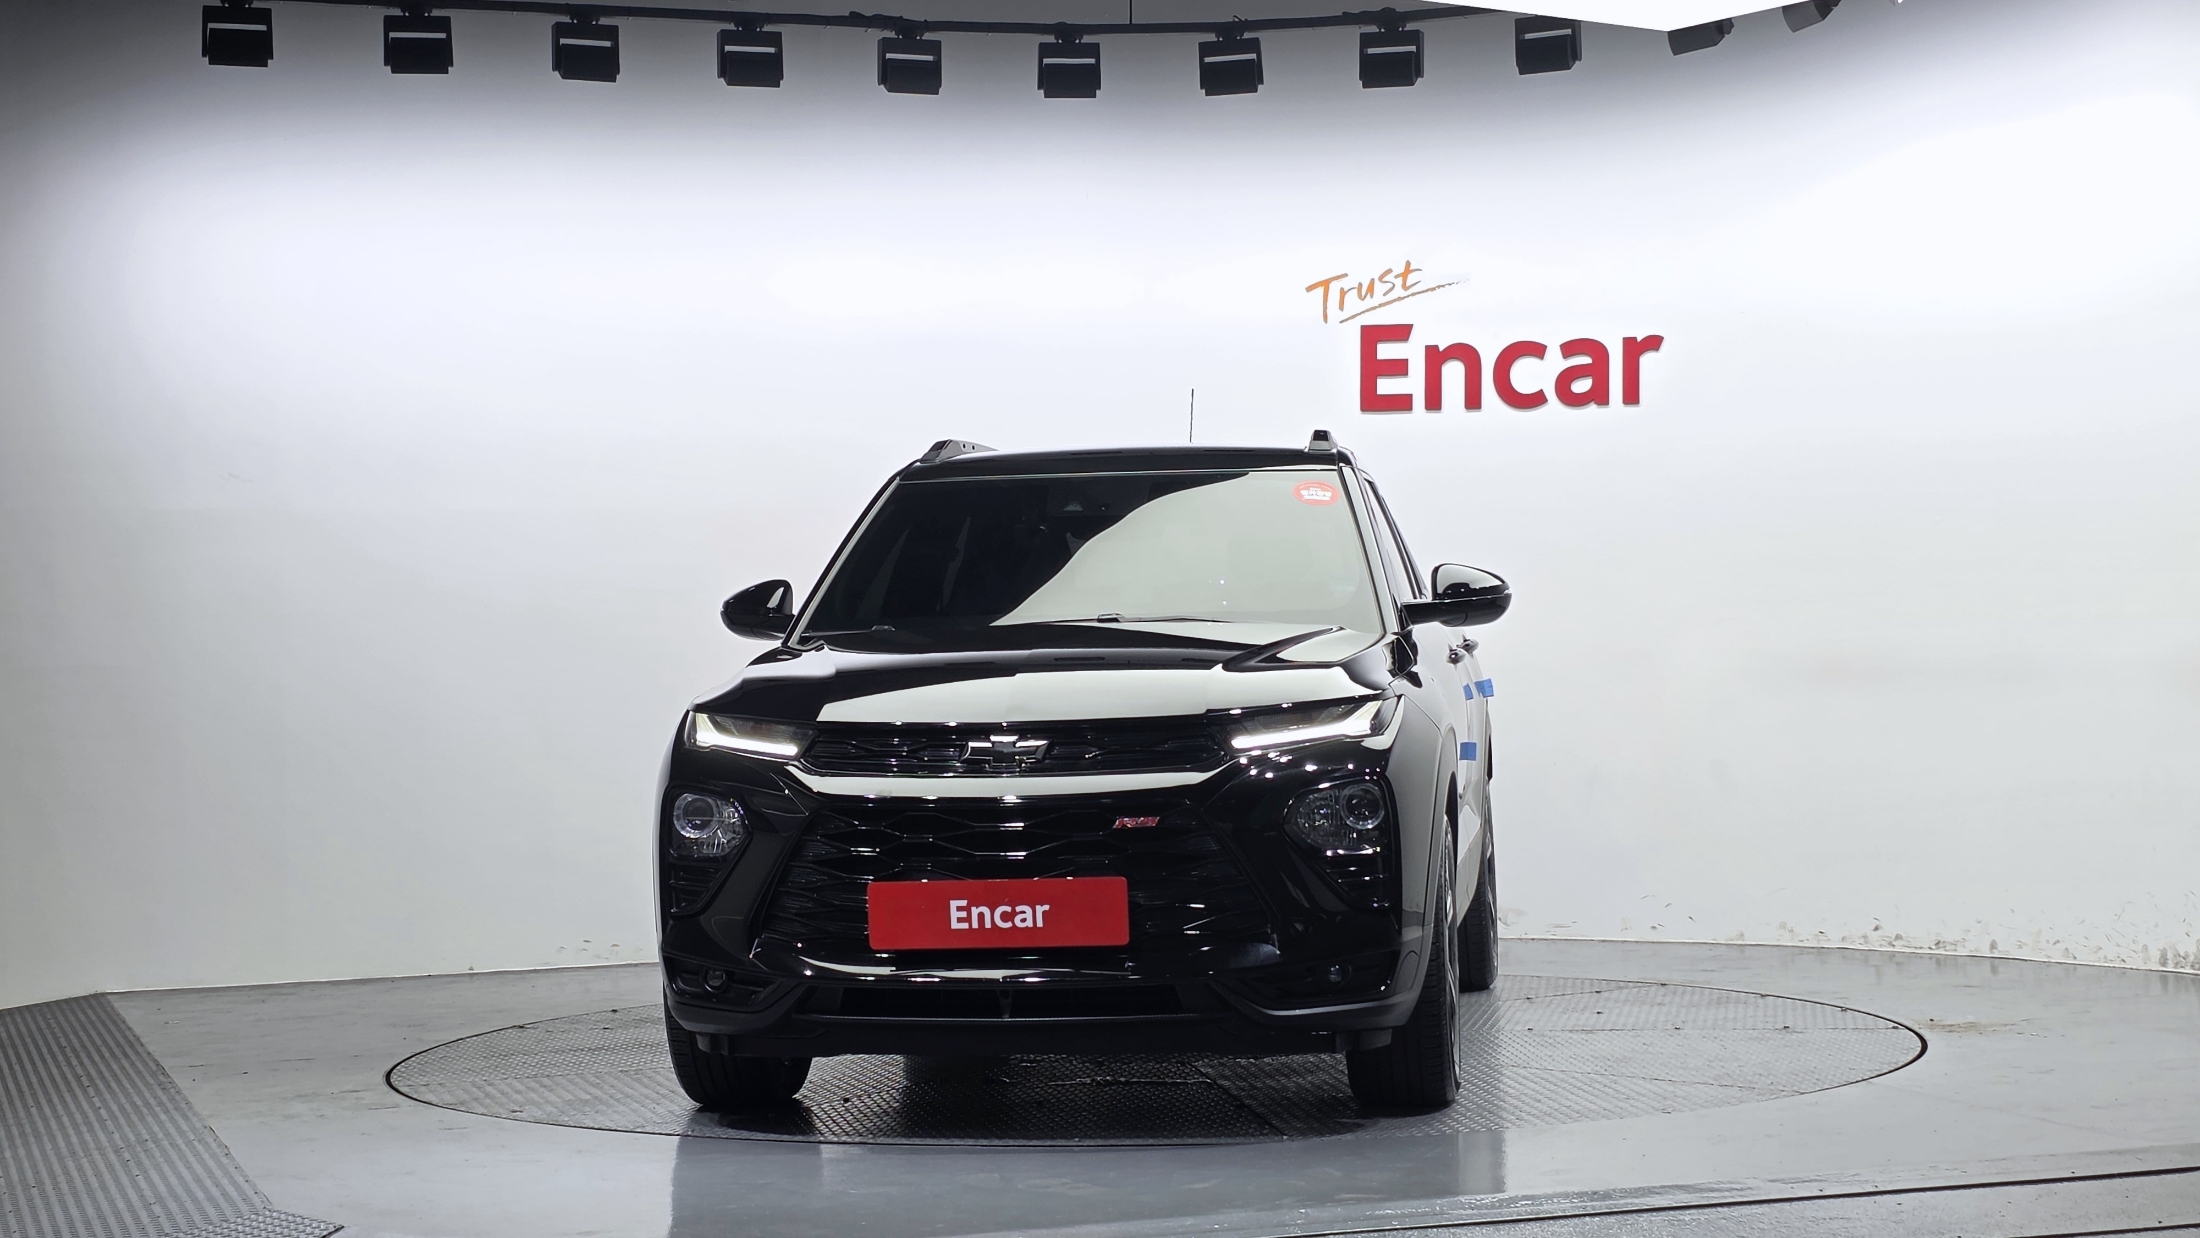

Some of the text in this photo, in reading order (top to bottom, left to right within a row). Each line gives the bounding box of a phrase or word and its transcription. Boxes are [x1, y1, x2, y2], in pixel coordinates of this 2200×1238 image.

[1305, 259, 1422, 324] Trust
[1360, 323, 1664, 413] Encar
[949, 899, 1050, 930] Encar
